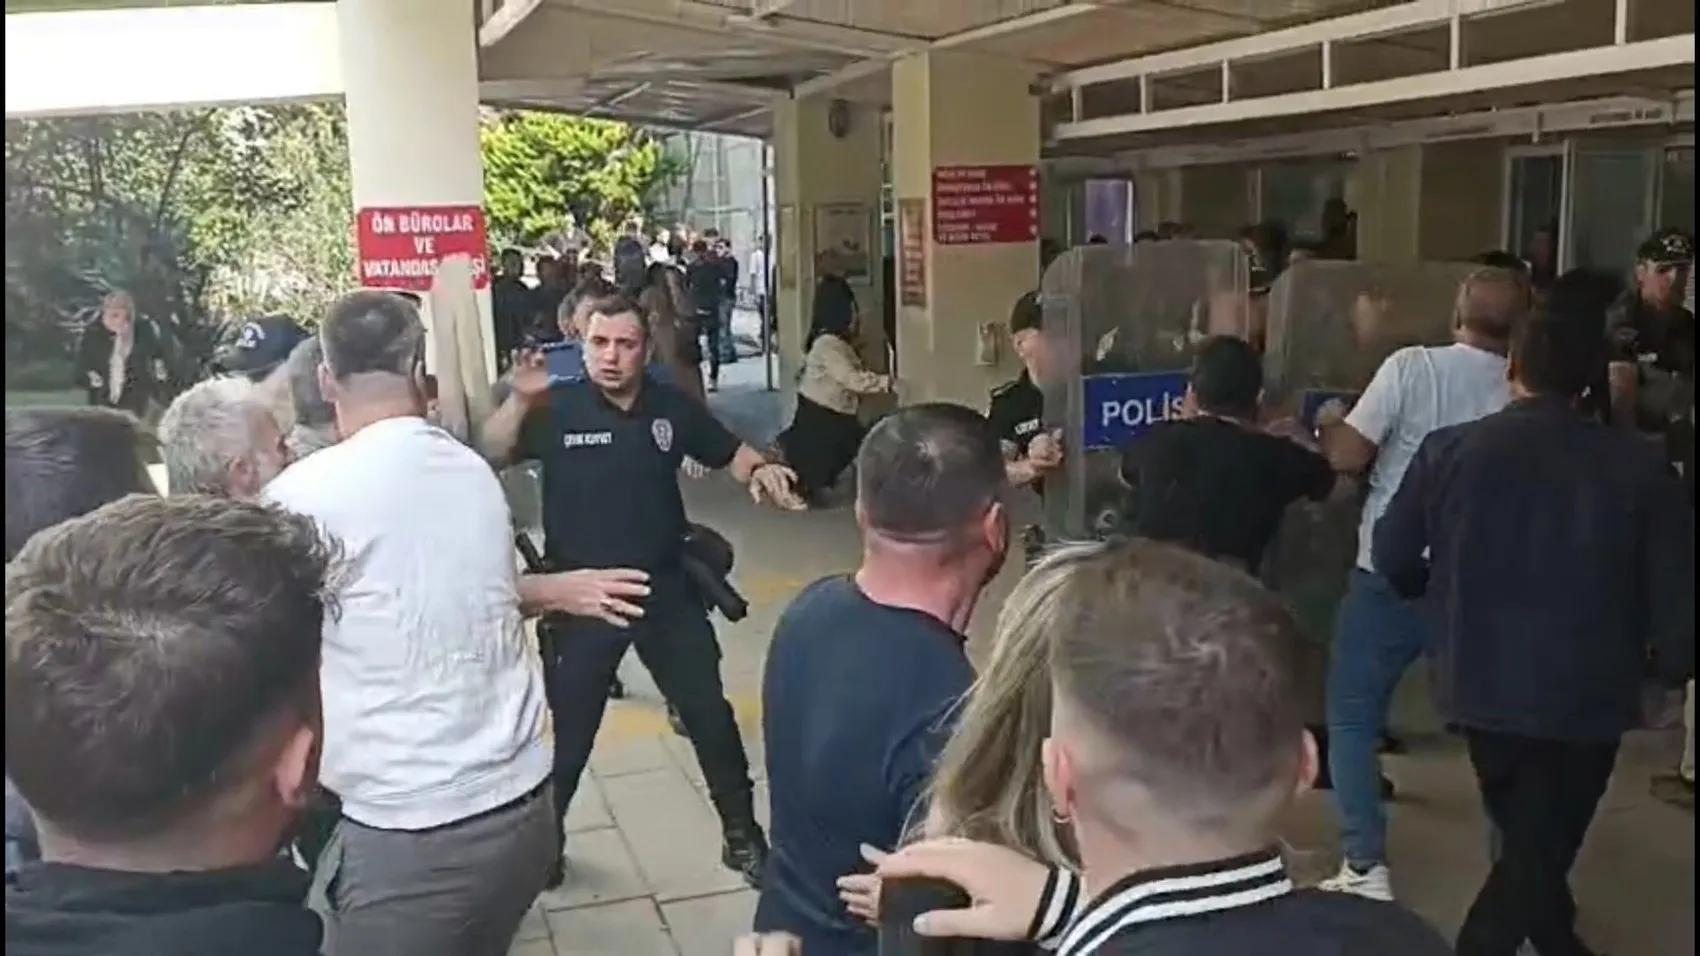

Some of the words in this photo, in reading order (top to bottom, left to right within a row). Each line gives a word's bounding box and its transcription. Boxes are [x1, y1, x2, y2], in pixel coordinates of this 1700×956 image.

[372, 211, 395, 233] ÖN
[399, 211, 474, 233] BÜROLAR
[413, 236, 435, 254] VE
